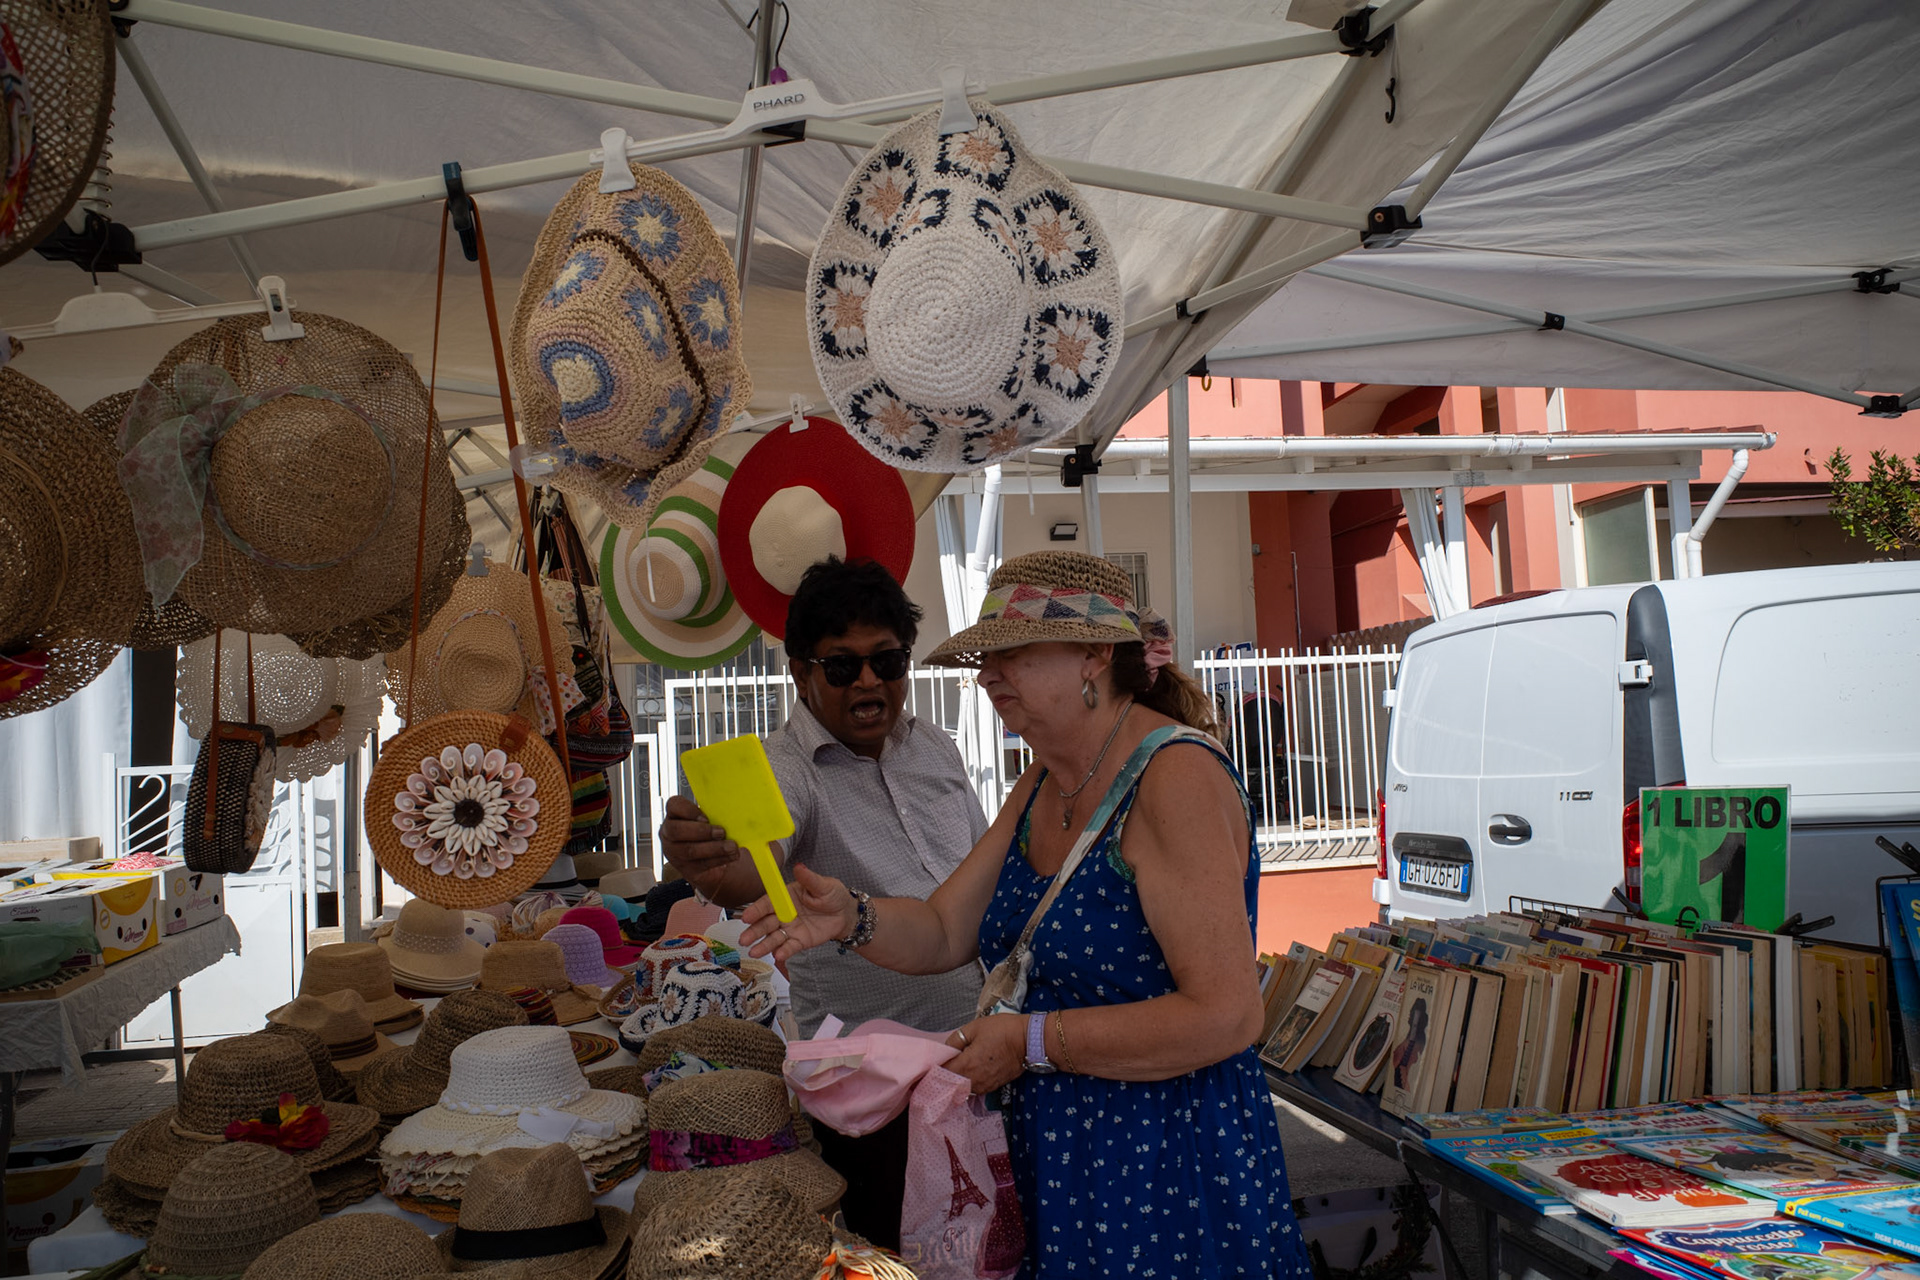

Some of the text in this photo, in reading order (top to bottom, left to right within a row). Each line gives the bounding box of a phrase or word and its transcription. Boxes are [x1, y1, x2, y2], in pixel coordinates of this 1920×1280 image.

[753, 93, 805, 111] PHARD
[1647, 795, 1782, 829] 1 LIBRO
[1699, 832, 1747, 925] 1
[1445, 1135, 1538, 1148] IMPARO
[942, 1225, 968, 1252] Paris
[1674, 1229, 1806, 1247] Cappuccetto
[1735, 1240, 1797, 1252] rosso
